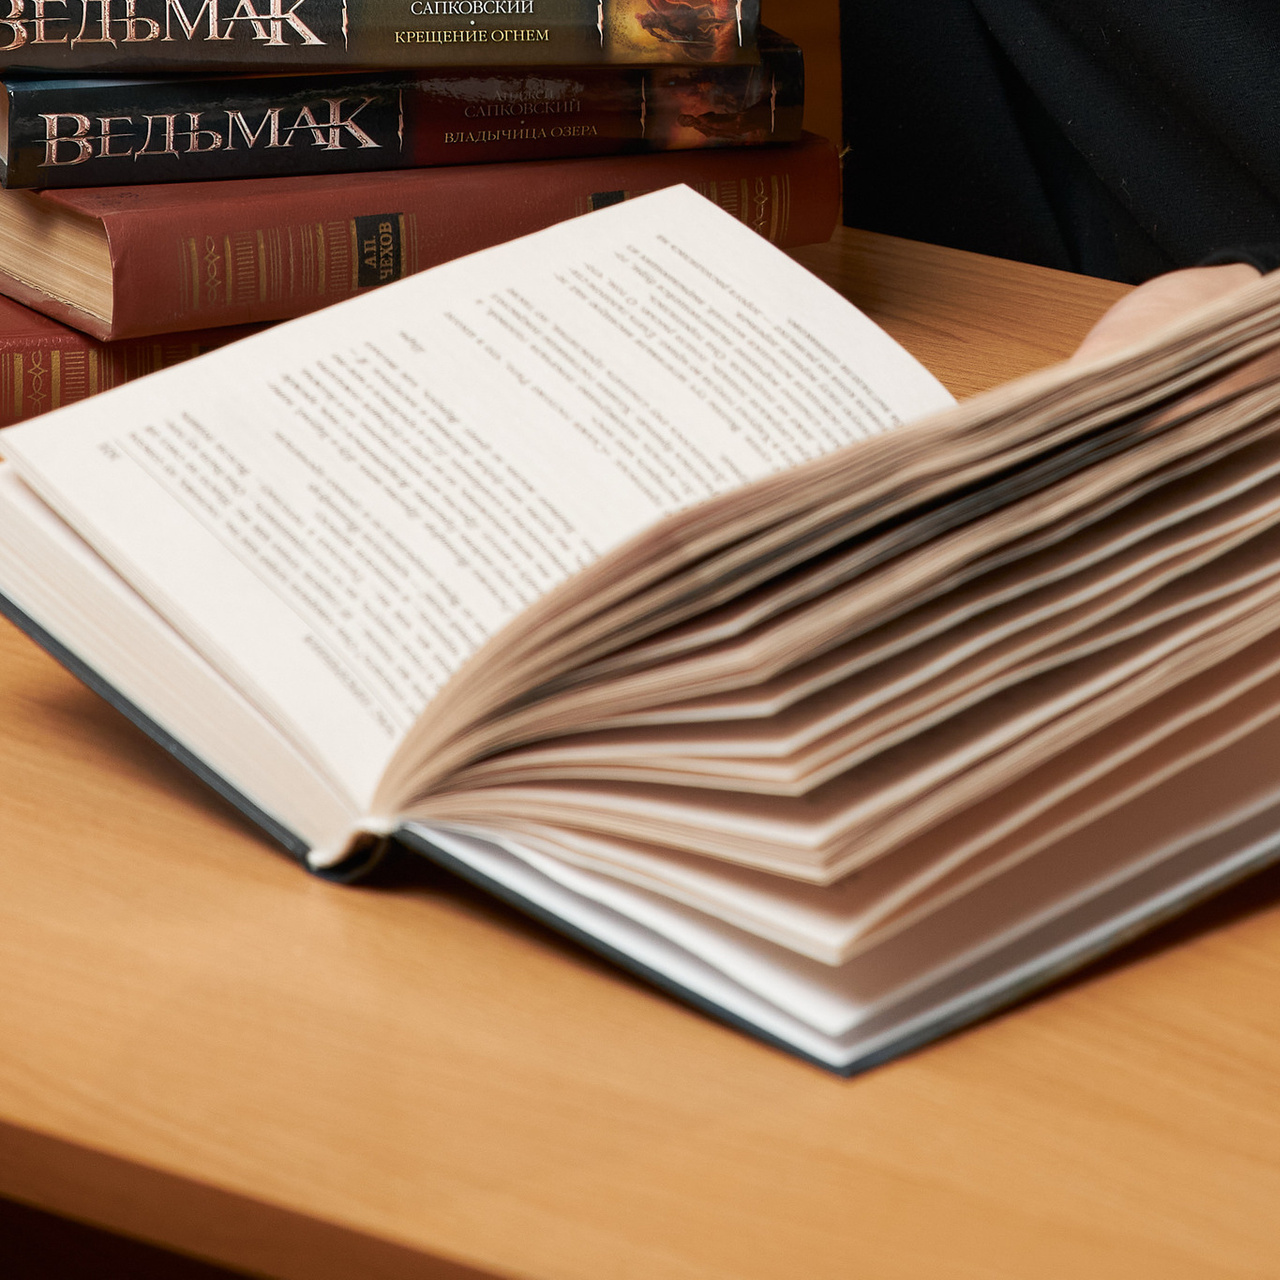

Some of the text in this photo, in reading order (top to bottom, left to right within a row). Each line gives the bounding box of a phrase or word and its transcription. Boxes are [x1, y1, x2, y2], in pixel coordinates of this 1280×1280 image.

[395, 30, 549, 44] КРЕЩЕНИЕ ОГНЕМ
[464, 98, 581, 119] САПКОВСКИЙ
[34, 96, 384, 168] ВЕДЬМАК
[445, 125, 598, 144] ВЛАДЫЧИЦА ОЗЕРА
[379, 221, 393, 280] ЧЕХОВ
